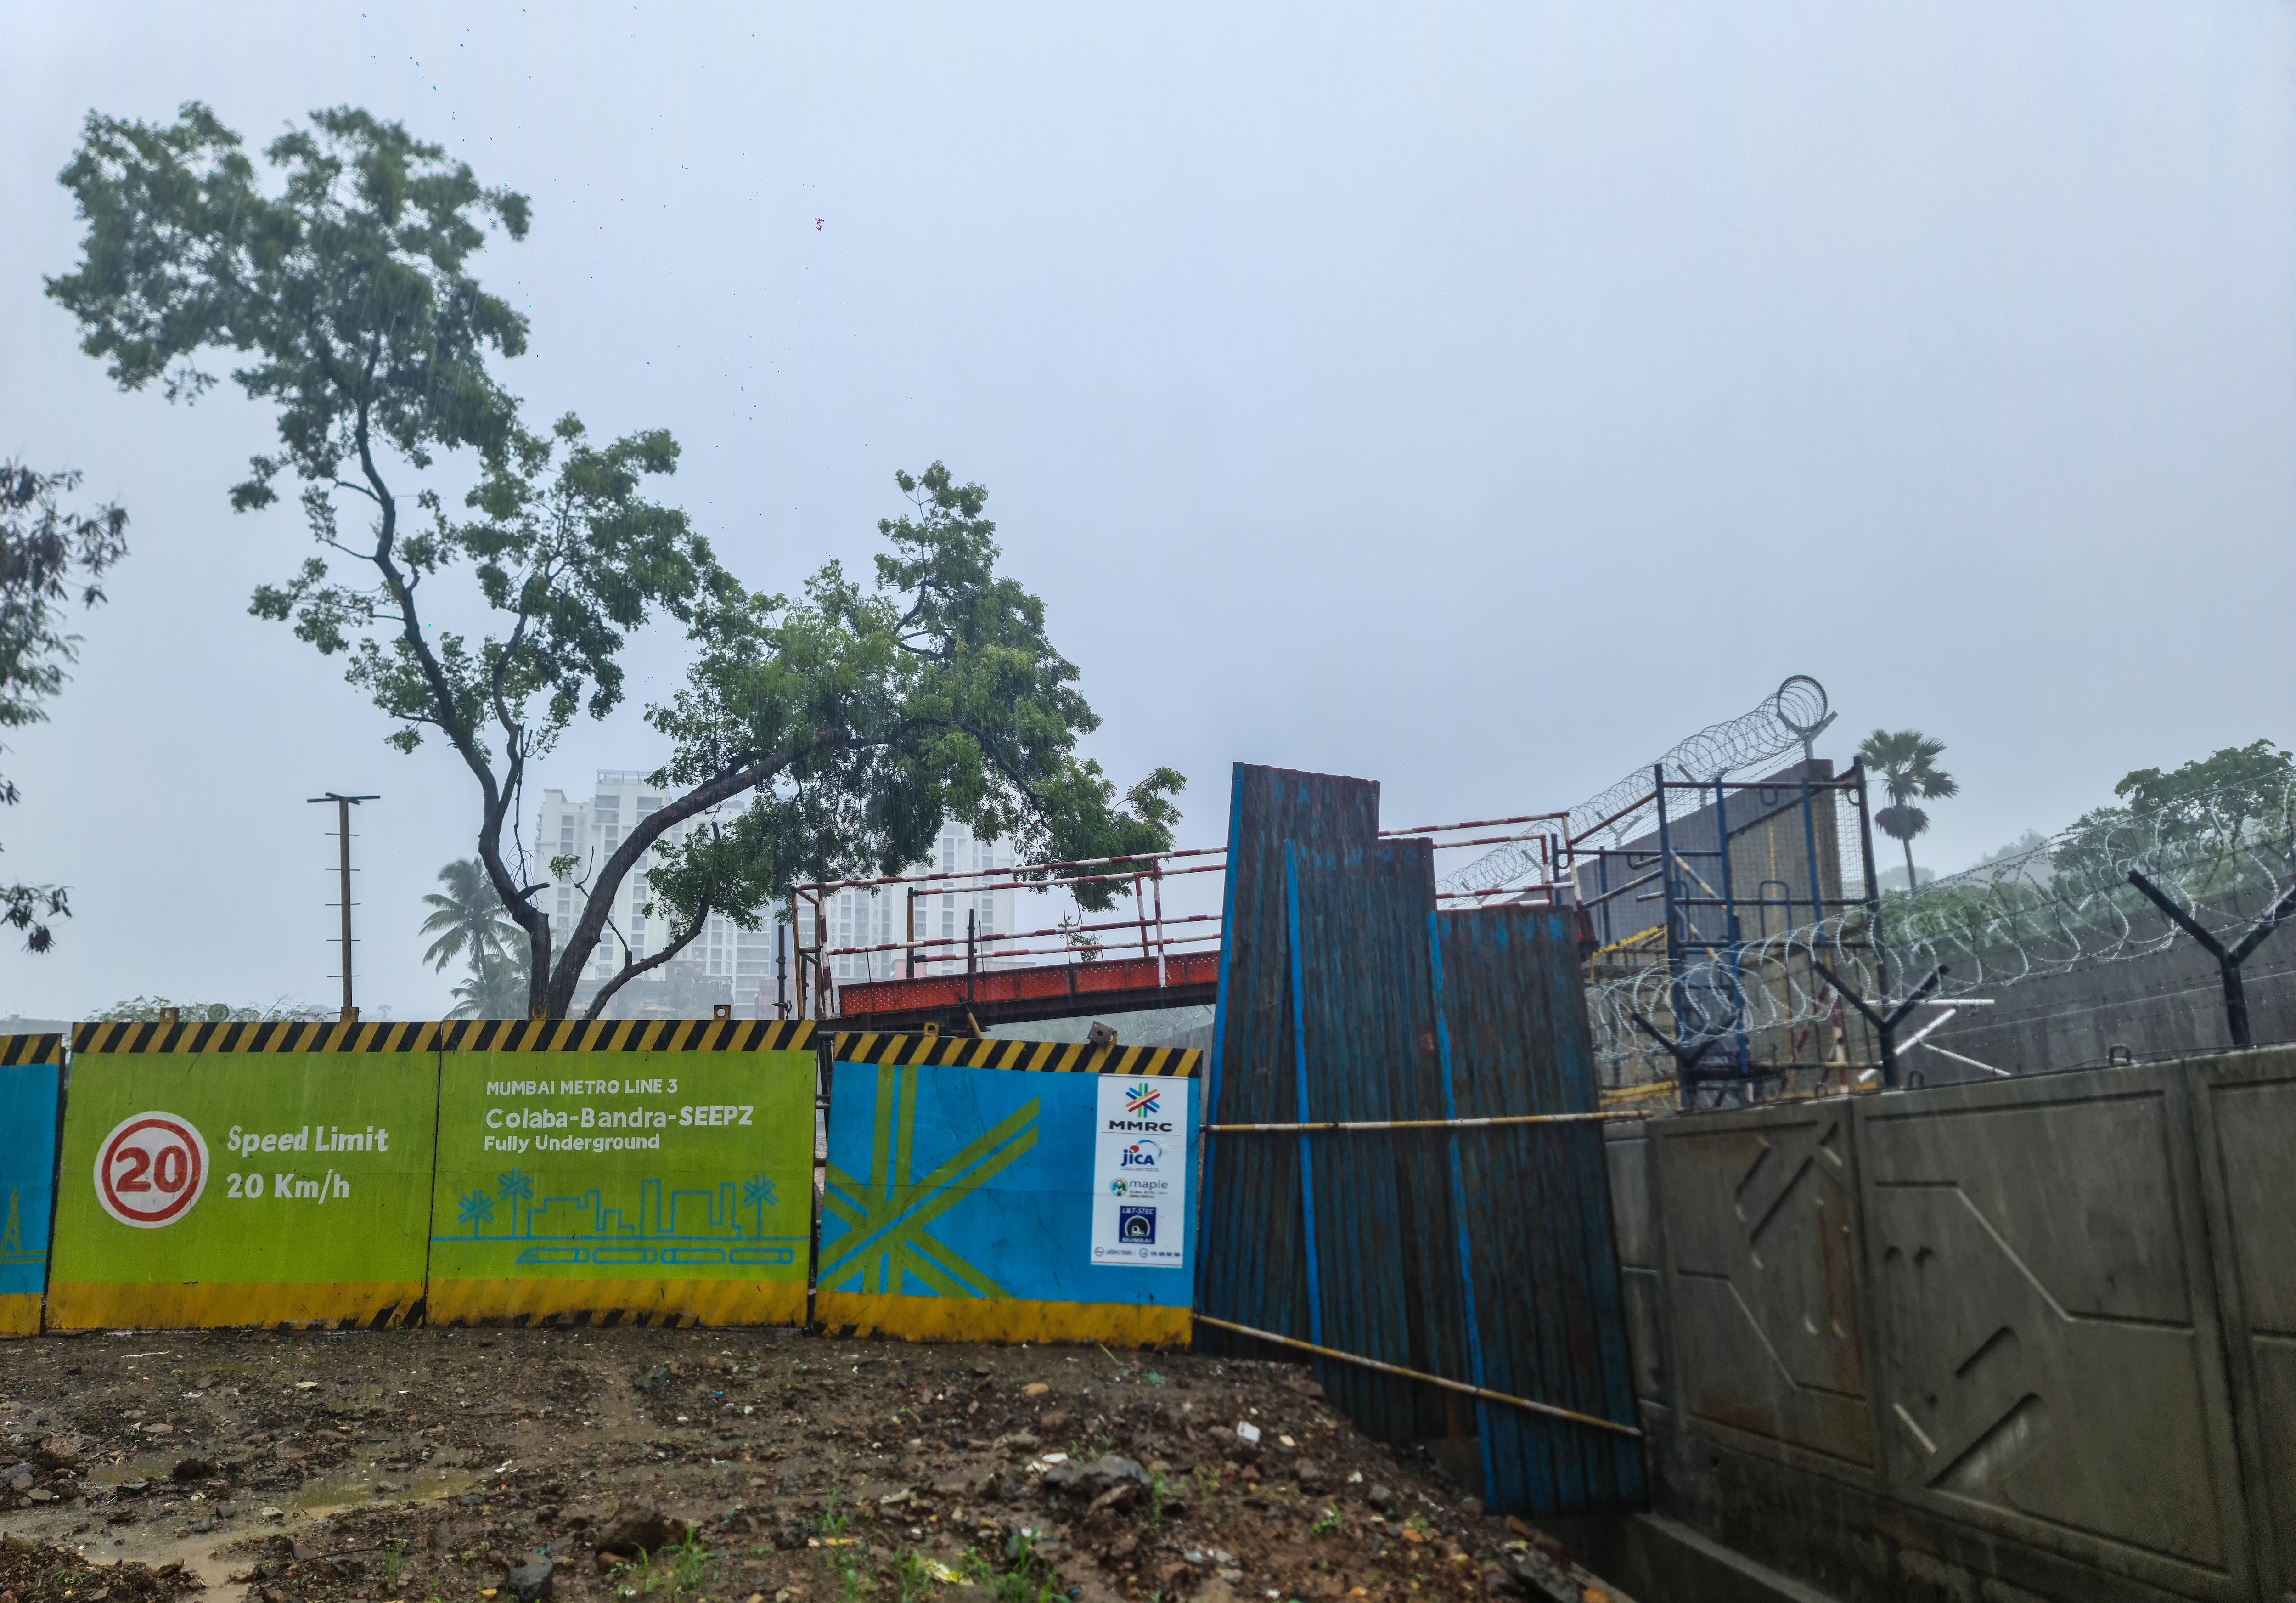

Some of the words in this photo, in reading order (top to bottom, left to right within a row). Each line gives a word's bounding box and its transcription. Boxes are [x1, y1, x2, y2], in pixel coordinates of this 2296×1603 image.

[486, 1080, 554, 1096] MUMBAI
[560, 1080, 620, 1095] METRO
[625, 1079, 663, 1094] LINE
[666, 1078, 678, 1094] 3
[486, 1105, 754, 1129] Colaba-Bandra-SEEPZ
[1109, 1120, 1173, 1132] MMRC
[227, 1125, 309, 1158] Speed
[315, 1125, 388, 1151] Limit
[484, 1135, 530, 1153] Fully
[535, 1134, 660, 1153] Underground
[116, 1146, 188, 1193] 20
[227, 1173, 264, 1198] 20
[275, 1169, 349, 1204] Km/h
[1130, 1179, 1169, 1190] maple
